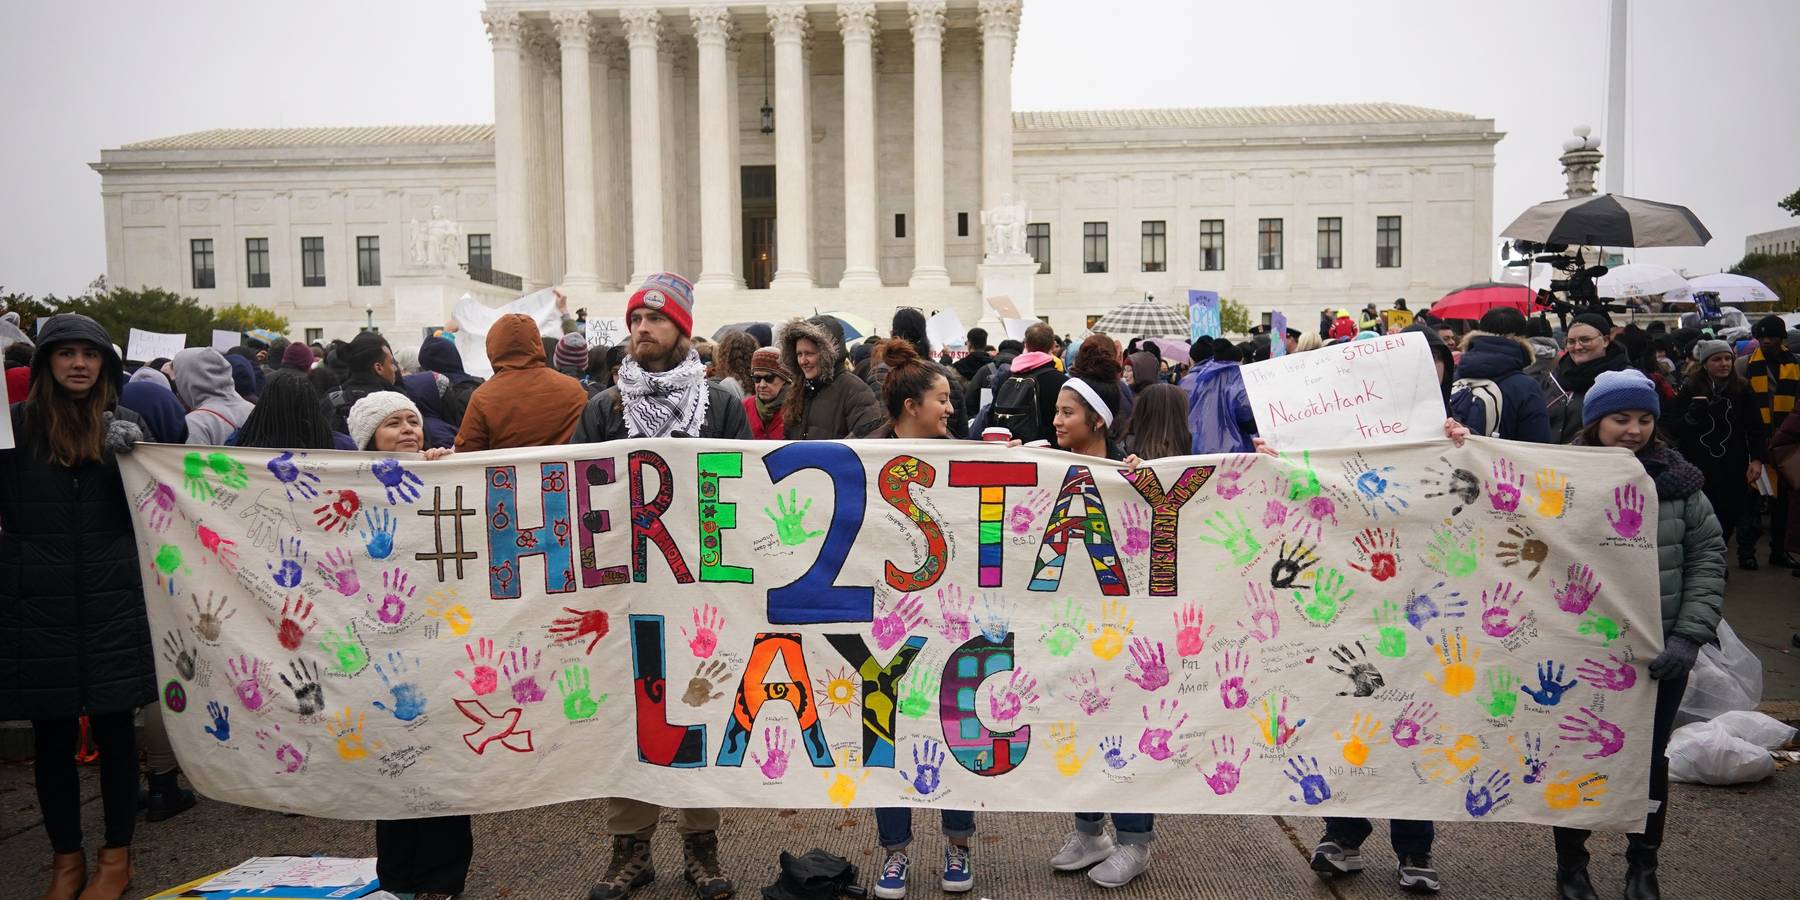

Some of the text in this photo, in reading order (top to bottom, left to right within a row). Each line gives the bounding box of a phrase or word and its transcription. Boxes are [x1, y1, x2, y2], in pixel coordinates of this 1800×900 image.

[589, 319, 618, 331] SAVE
[587, 335, 615, 347] KIDS
[1250, 336, 1406, 384] This land was STOLEN
[1303, 366, 1352, 388] from the
[1267, 379, 1384, 429] Nacotchtank
[1356, 413, 1408, 440] tribe
[629, 613, 1032, 778] LAYC
[1177, 681, 1209, 694] AMOR
[1524, 704, 1550, 714] Brandon
[1328, 766, 1379, 777] NO HATE
